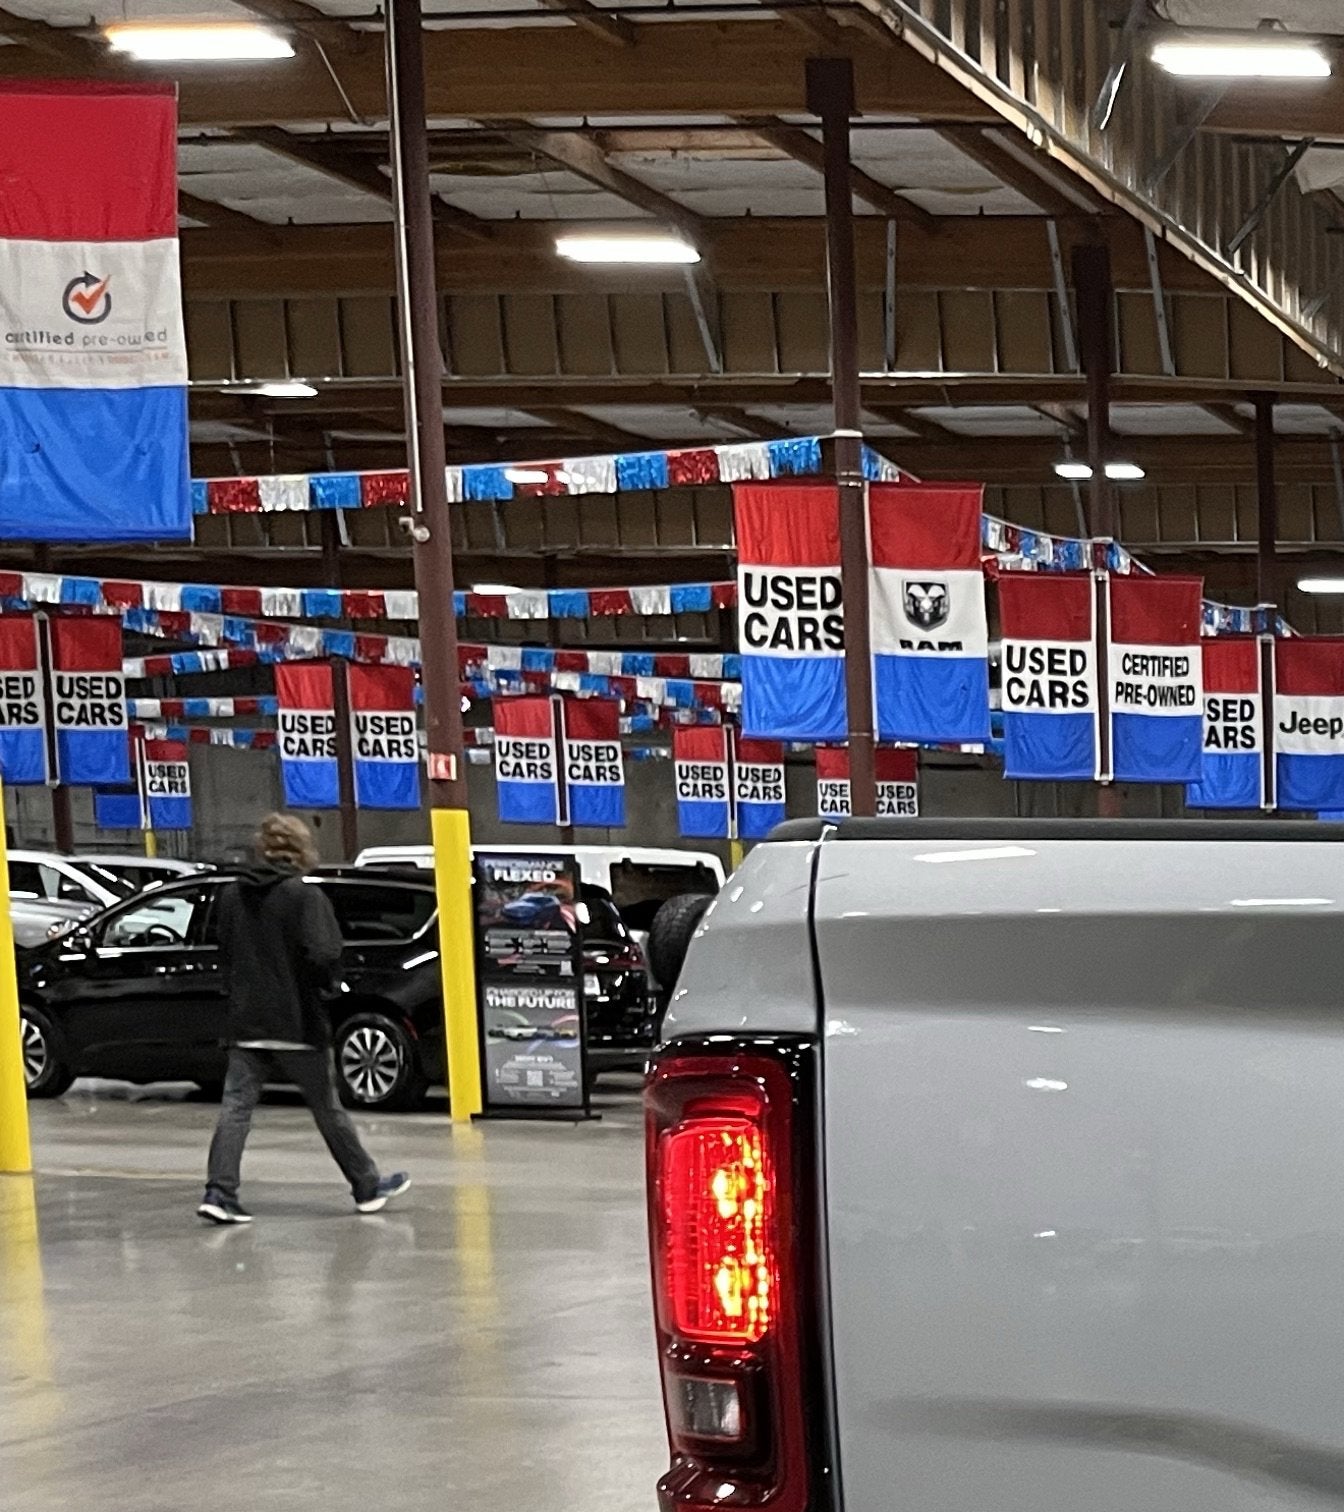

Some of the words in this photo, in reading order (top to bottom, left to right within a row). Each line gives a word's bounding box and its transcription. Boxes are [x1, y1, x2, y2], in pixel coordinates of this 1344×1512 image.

[744, 573, 842, 611] USED
[744, 612, 844, 651] CARS
[899, 639, 963, 651] RAM
[1006, 645, 1087, 676] USED
[1122, 653, 1189, 677] CERTIFIED
[0, 676, 35, 699] ED
[56, 675, 122, 699] USED
[1006, 677, 1089, 708] CARS
[1115, 681, 1196, 707] PRE-OWNED
[57, 702, 123, 726] CARS
[1204, 698, 1255, 722] SED
[281, 714, 336, 735] USED
[355, 715, 413, 736] USED
[1279, 711, 1343, 739] Jeep
[283, 736, 336, 757] CARS
[357, 737, 415, 758] CARS
[1204, 725, 1256, 749] ARS
[498, 741, 550, 760] USED
[568, 743, 618, 762] USED
[148, 764, 186, 778] USED
[499, 761, 552, 779] CARS
[568, 764, 621, 782] CARS
[678, 765, 724, 781] USED
[737, 766, 782, 783] USED
[149, 778, 187, 793] CARS
[679, 782, 725, 798] CARS
[737, 783, 783, 801] CARS
[819, 783, 849, 798] USE
[875, 784, 915, 799] USED
[820, 799, 850, 814] CAR
[875, 800, 916, 814] CARS
